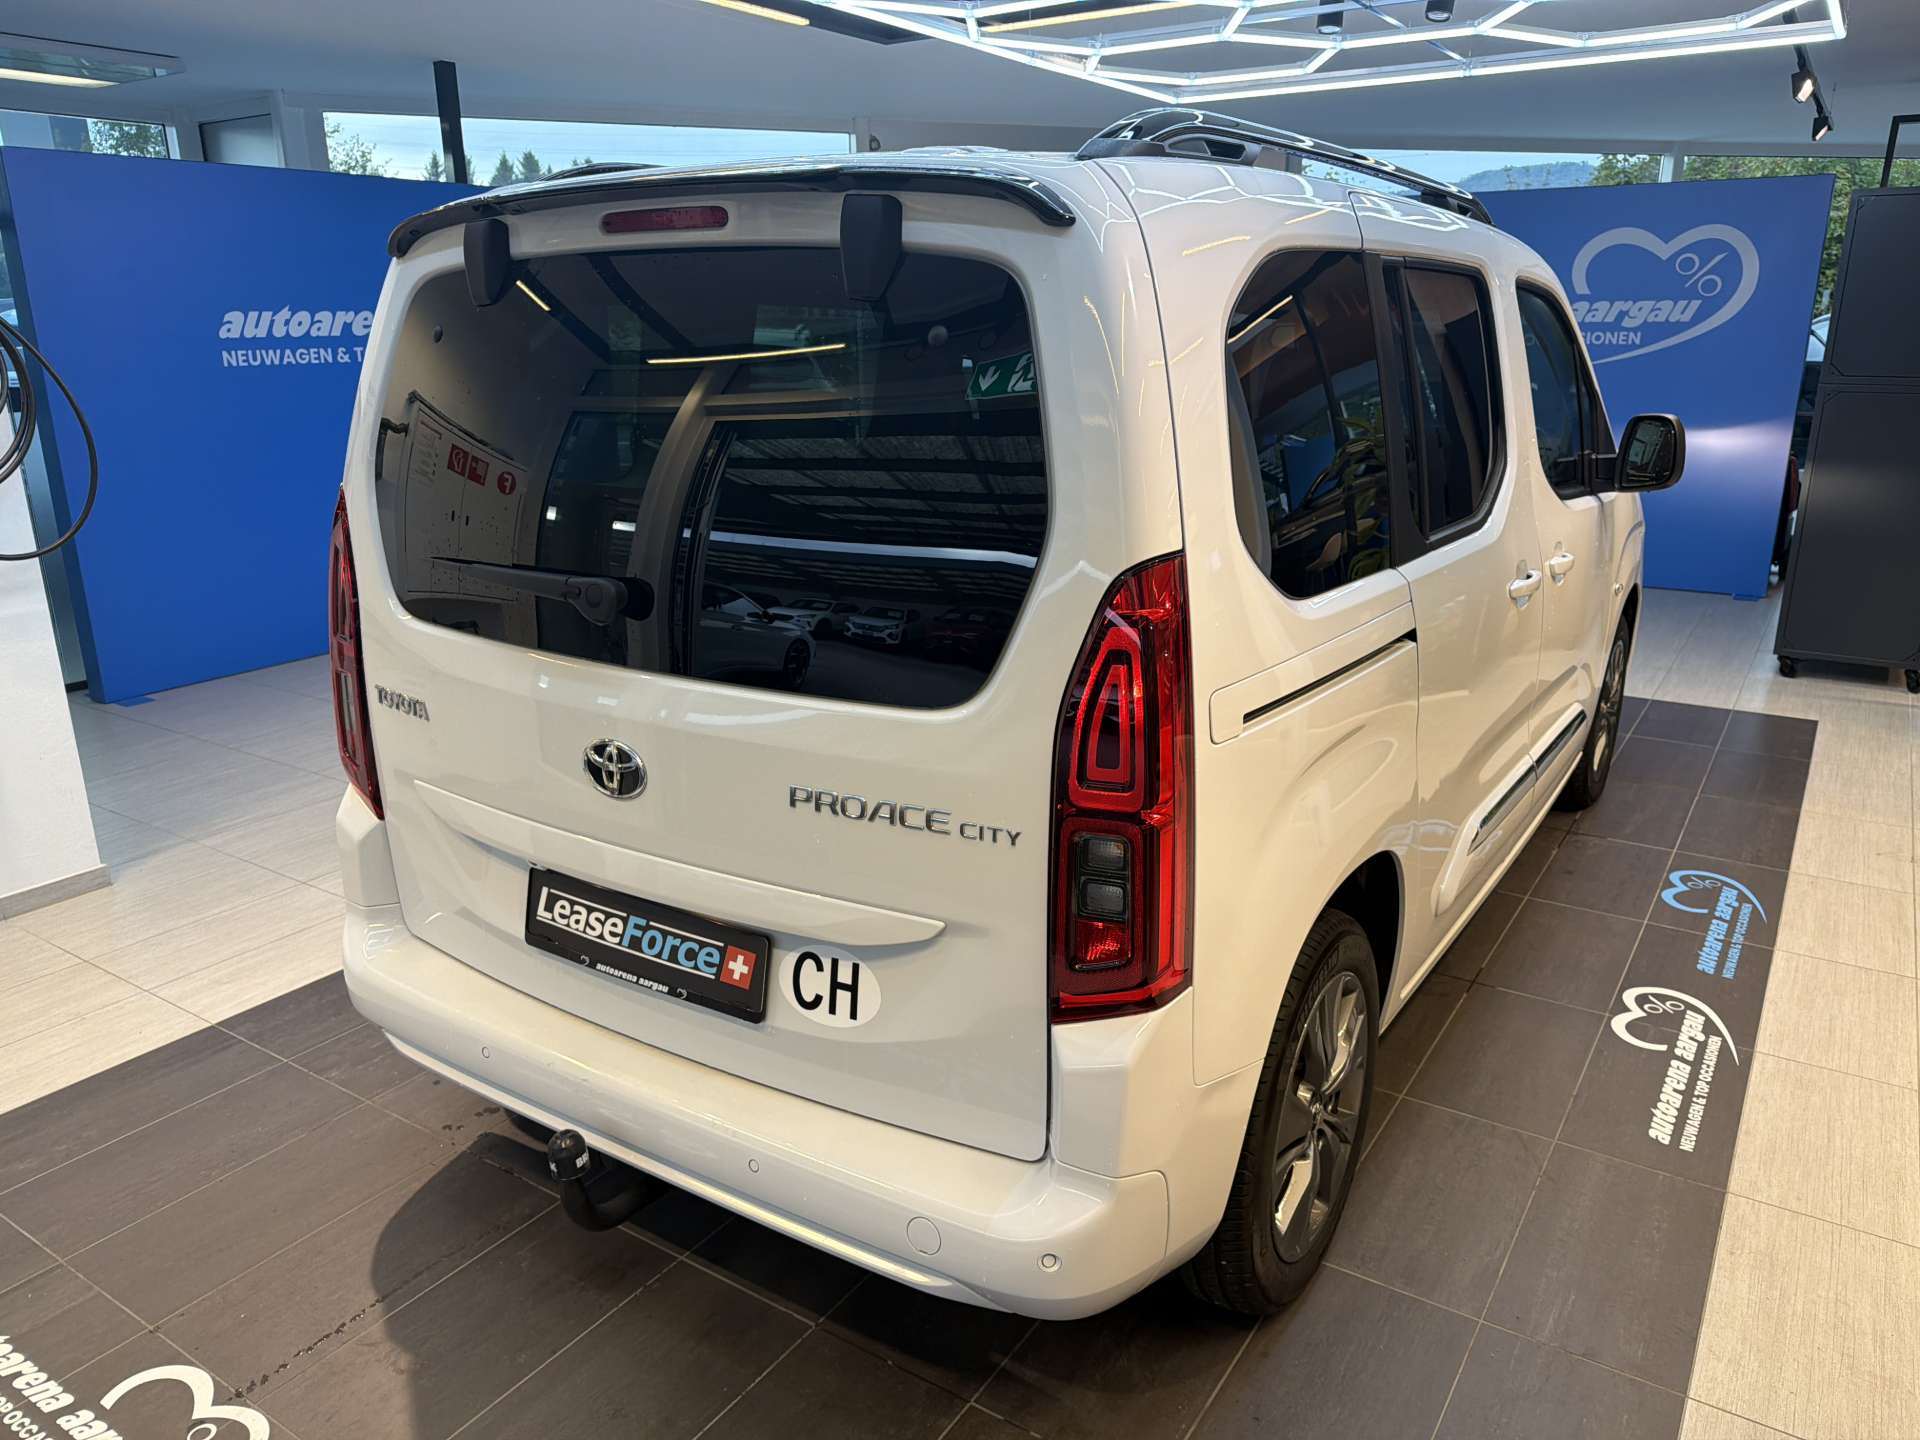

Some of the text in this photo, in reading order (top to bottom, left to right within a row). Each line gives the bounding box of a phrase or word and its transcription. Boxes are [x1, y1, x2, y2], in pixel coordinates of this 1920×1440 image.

[221, 347, 366, 367] NEUWAGEN & T
[1583, 331, 1641, 345] IONEN
[374, 684, 430, 722] TOYOTA
[789, 784, 1022, 846] PROACE CITY
[536, 886, 721, 975] LeaseForce
[596, 963, 669, 993] autoarena aargau
[792, 951, 860, 1020] CH
[1649, 1010, 1706, 1145] autoarena aargau
[1699, 1034, 1722, 1082] OCCASIONEN
[1694, 1080, 1711, 1097] TOP
[1679, 1105, 1705, 1152] NEUWAGEN
